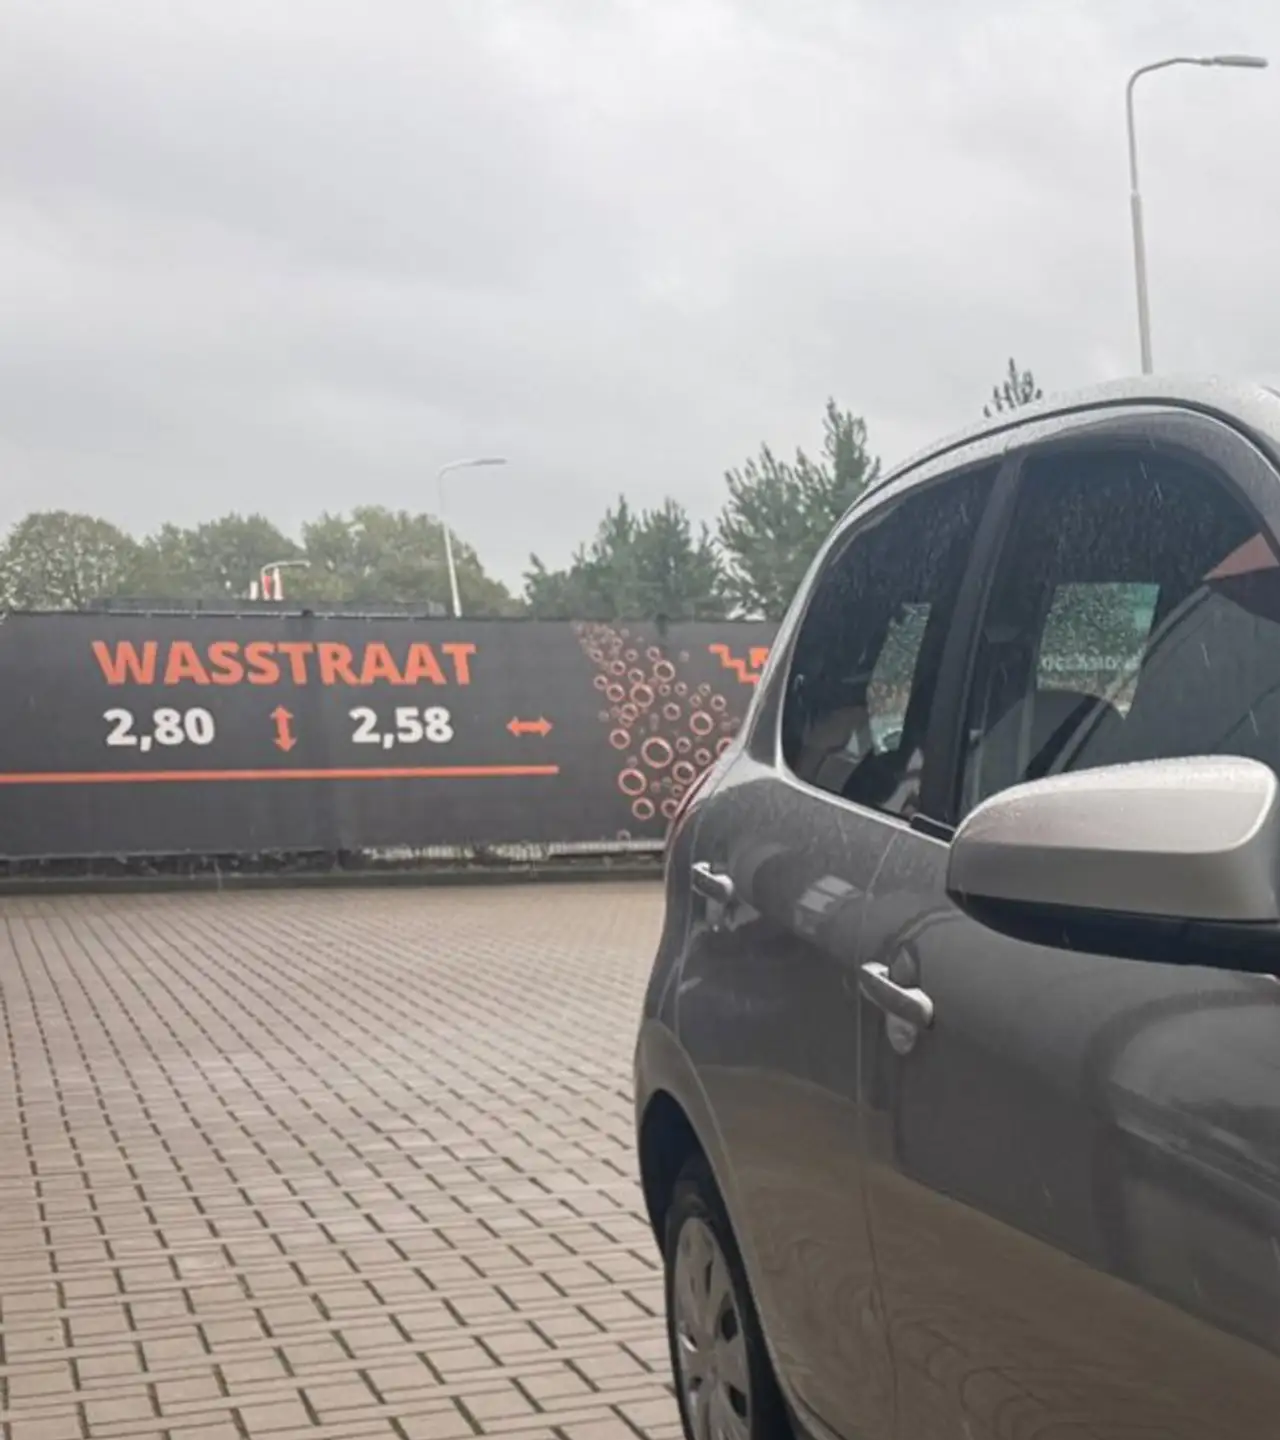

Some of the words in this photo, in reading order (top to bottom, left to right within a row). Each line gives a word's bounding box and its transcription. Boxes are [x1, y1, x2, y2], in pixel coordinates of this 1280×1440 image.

[94, 640, 477, 686] WASSTRAAT
[104, 707, 215, 752] 2,80
[349, 706, 454, 750] 2,58
